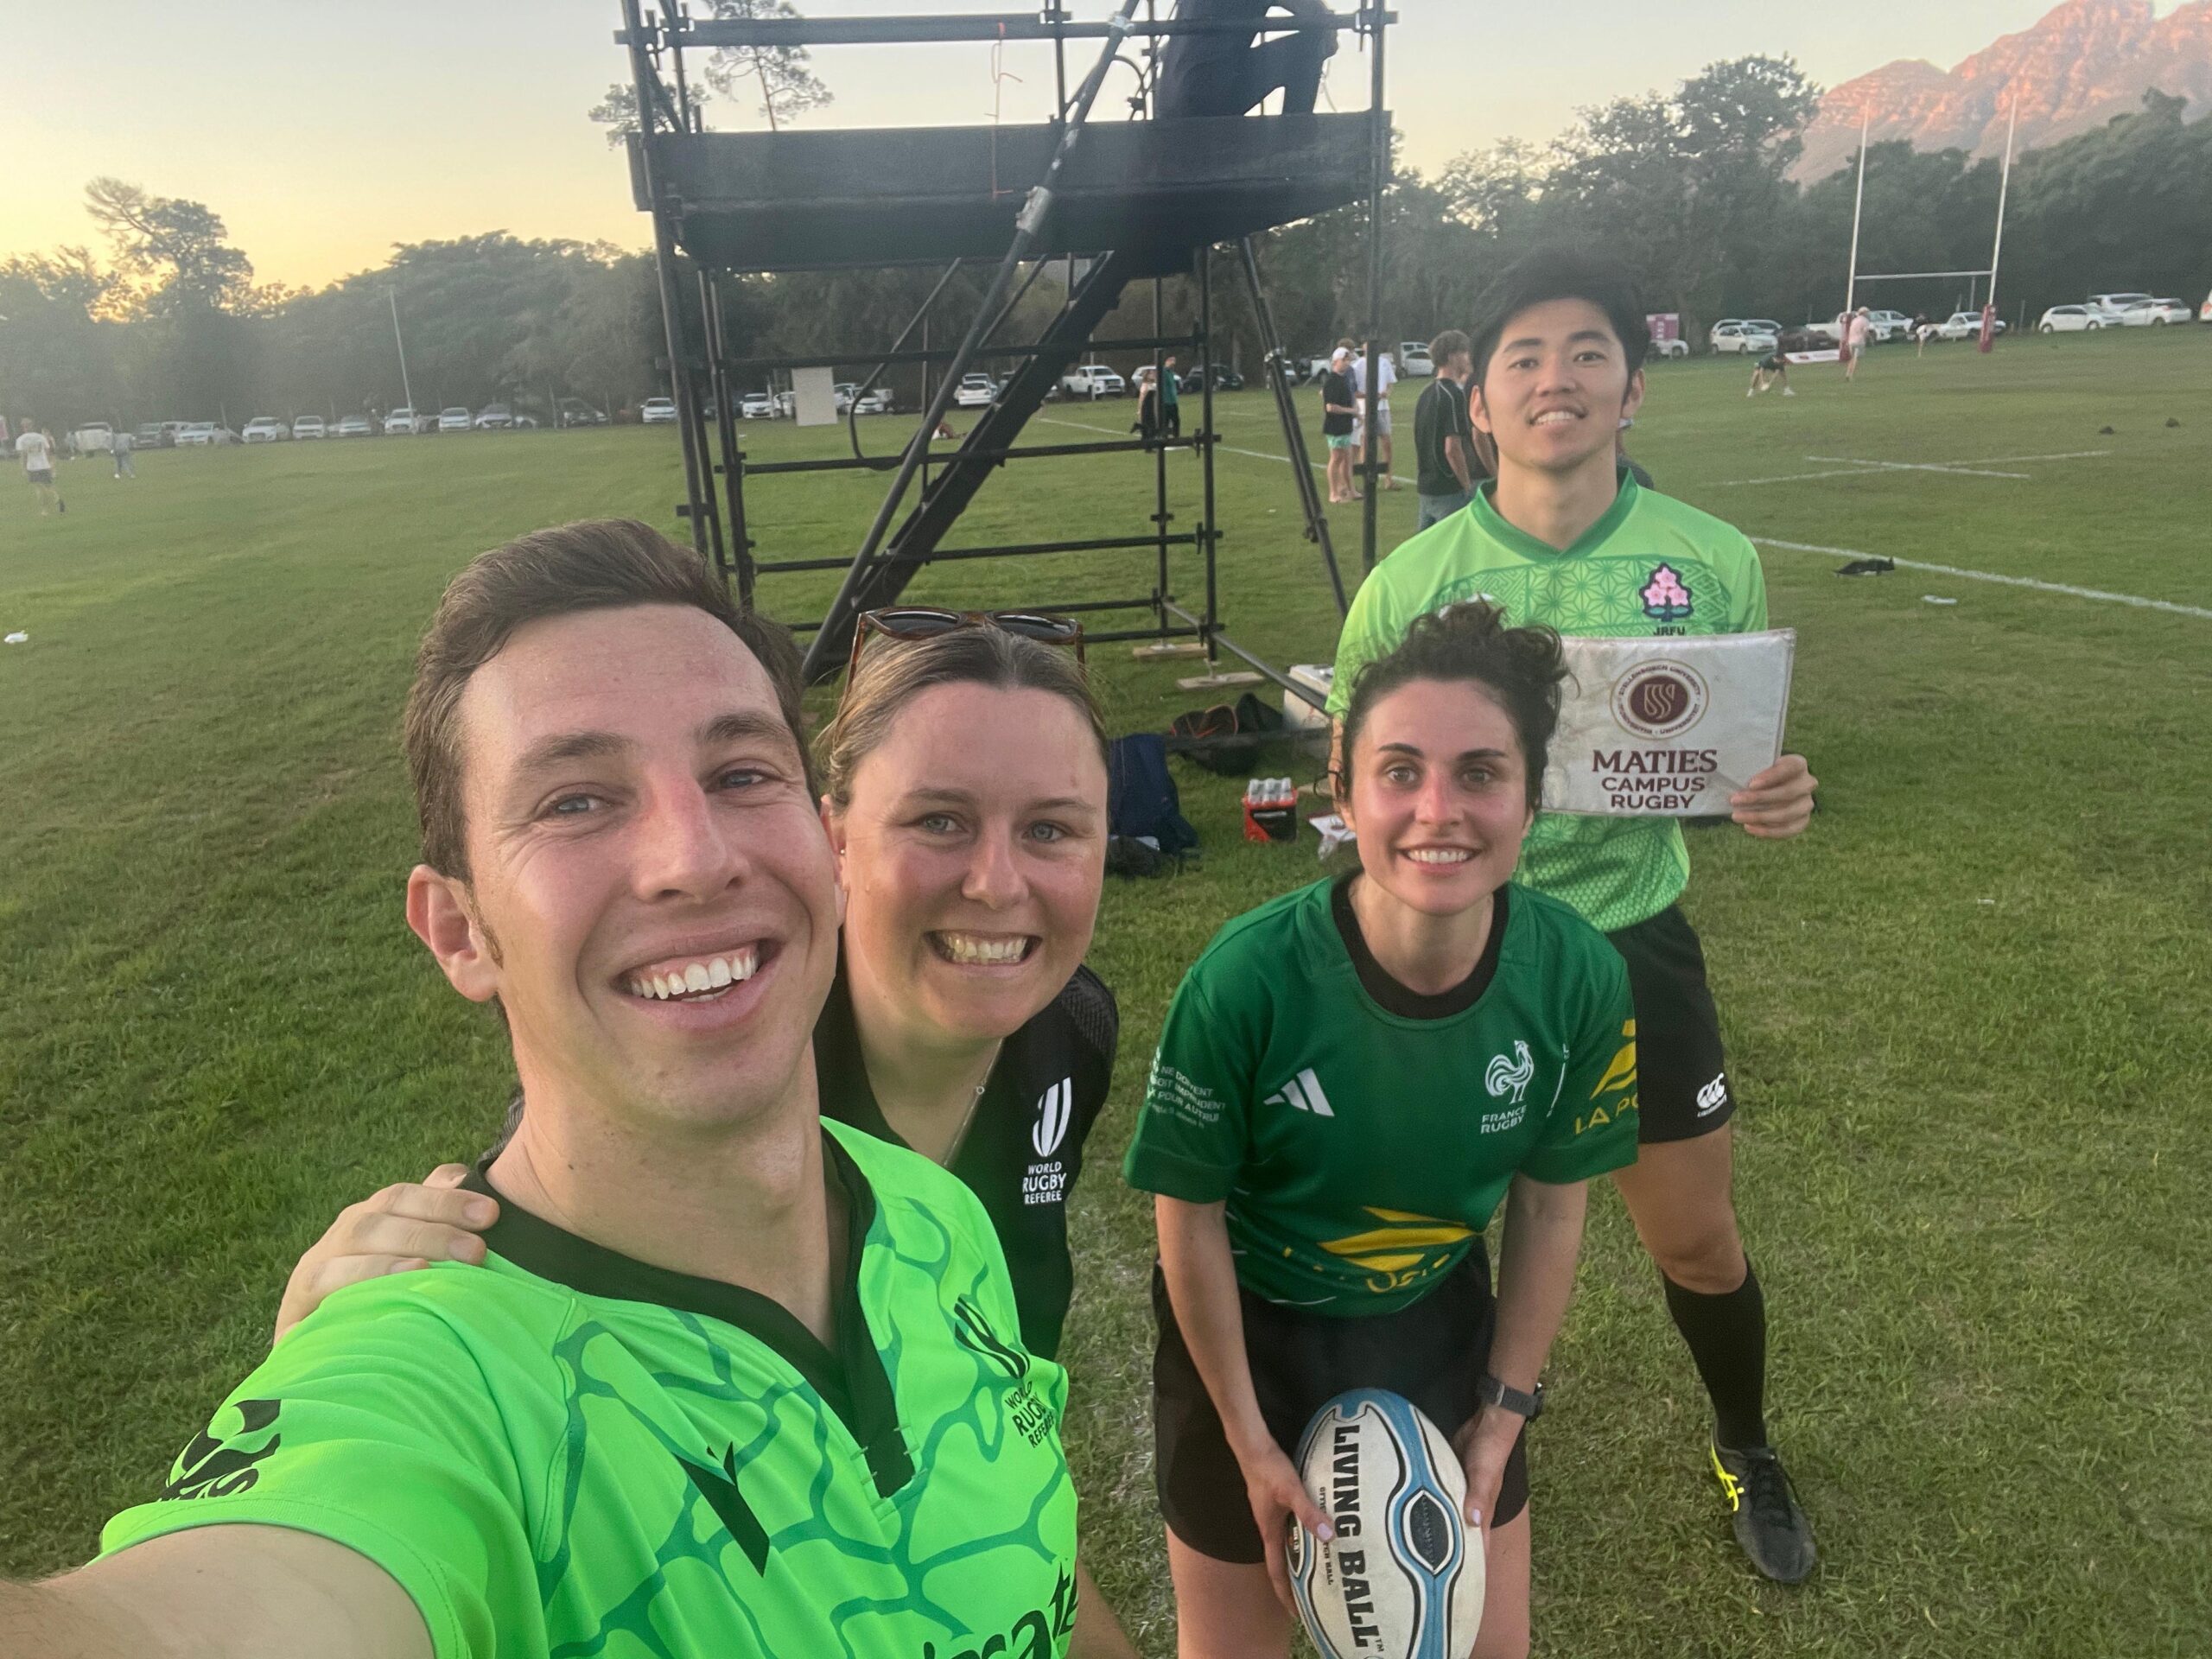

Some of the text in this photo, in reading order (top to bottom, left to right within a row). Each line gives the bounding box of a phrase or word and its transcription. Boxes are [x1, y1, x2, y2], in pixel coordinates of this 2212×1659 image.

[1652, 626, 1686, 636] JRFU
[1592, 748, 1719, 774] MATIES
[1601, 776, 1706, 792] CAMPUS
[1610, 793, 1695, 810] RUGBY
[1482, 1104, 1527, 1123] FRANCE
[1574, 1107, 1611, 1135] LA
[1480, 1114, 1524, 1135] RUGBY
[1027, 1161, 1062, 1175] WORLD
[1022, 1172, 1067, 1193] RUGBY
[1024, 1190, 1063, 1205] REFEREE
[1004, 1381, 1033, 1410] WORLD
[1332, 1424, 1362, 1539] LIVING
[1337, 1549, 1381, 1649] BALL
